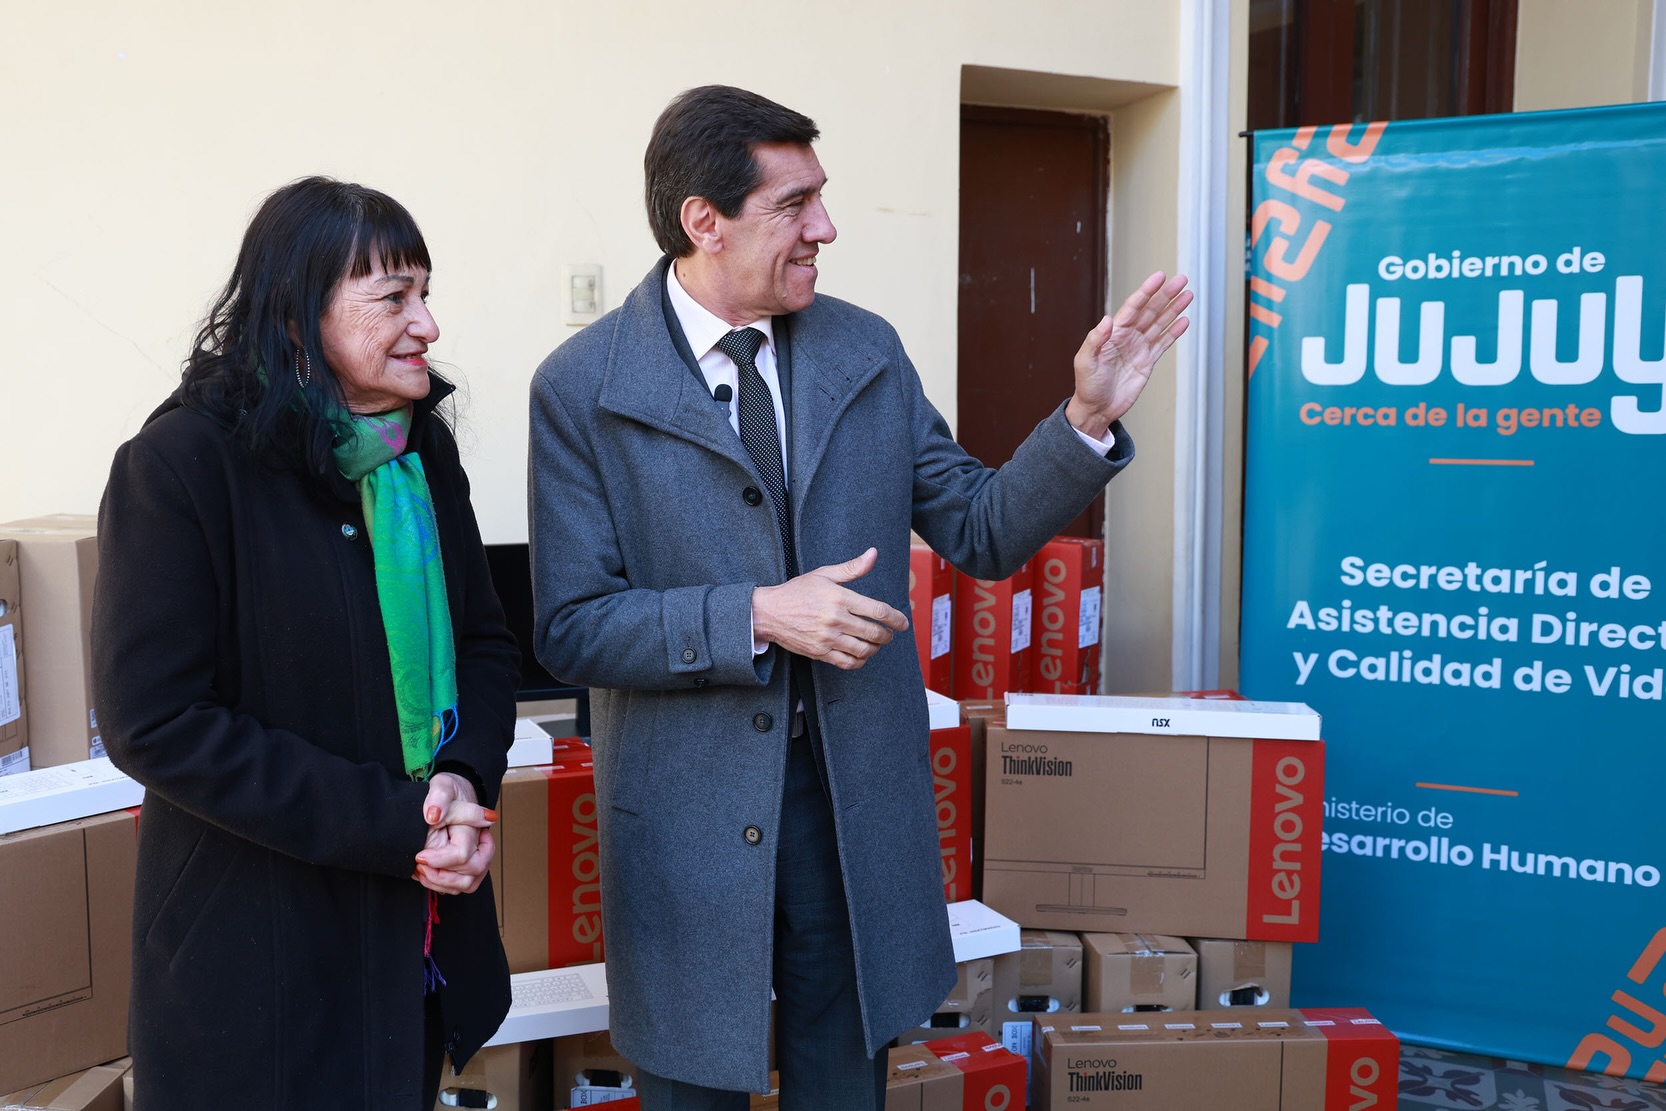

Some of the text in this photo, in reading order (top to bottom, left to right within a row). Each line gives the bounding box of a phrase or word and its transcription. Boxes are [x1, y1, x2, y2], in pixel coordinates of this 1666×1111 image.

[1378, 247, 1606, 280] Gobierno de
[1300, 402, 1601, 436] Cerca de la gente
[1340, 556, 1651, 600] Secretaría de
[1287, 599, 1666, 651] Asistencia Direct
[1293, 649, 1666, 700] y Calidad de Vid
[1001, 742, 1049, 754] Lenovo
[1001, 755, 1072, 777] ThinkVision
[1323, 797, 1454, 829] nisterio de
[1262, 756, 1305, 925] Lenovo
[1321, 831, 1661, 887] sarrollo Humano
[1067, 1058, 1117, 1070] Lenovo
[1067, 1071, 1142, 1092] ThinkVision
